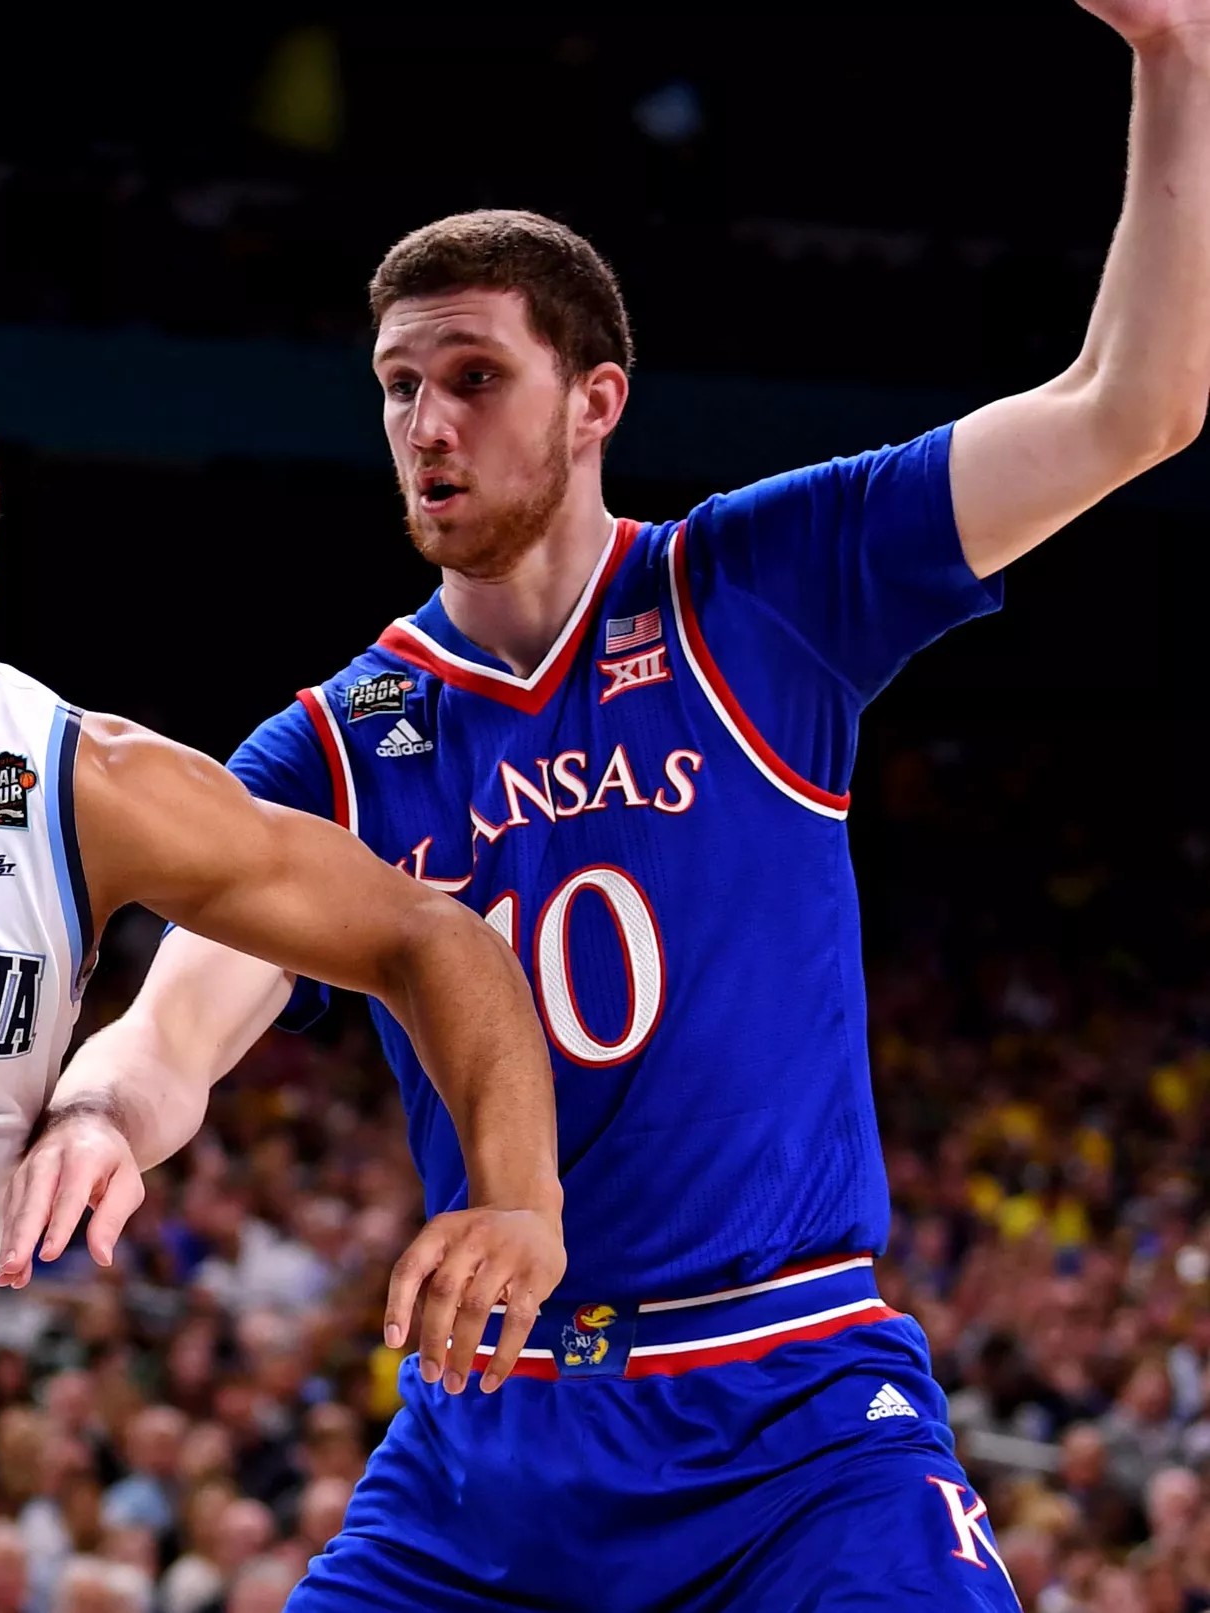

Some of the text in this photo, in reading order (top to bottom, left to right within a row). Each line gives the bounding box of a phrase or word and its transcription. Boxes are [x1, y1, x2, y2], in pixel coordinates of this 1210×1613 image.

[596, 644, 673, 704] XII
[349, 679, 398, 699] FINAL
[354, 686, 400, 706] FOUR
[376, 740, 434, 757] adidas
[866, 1404, 919, 1422] adida
